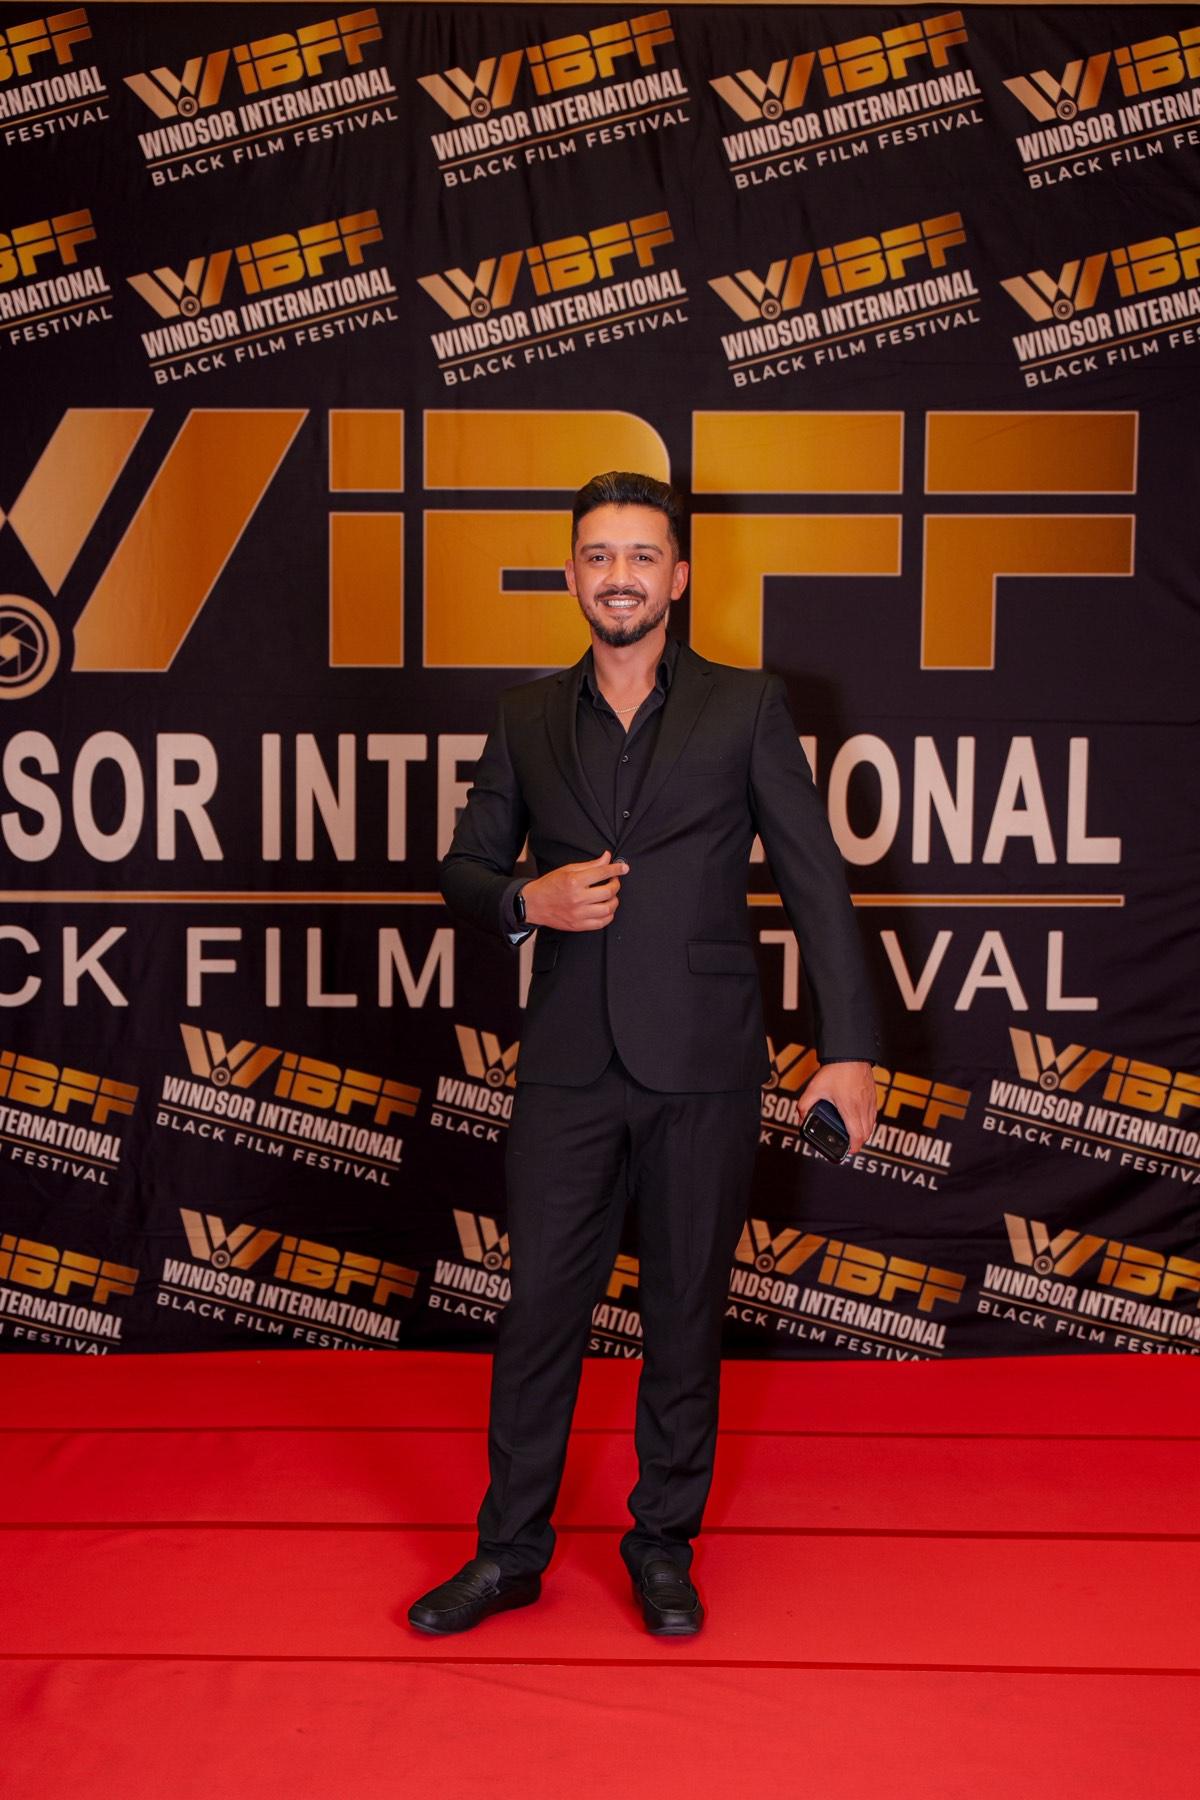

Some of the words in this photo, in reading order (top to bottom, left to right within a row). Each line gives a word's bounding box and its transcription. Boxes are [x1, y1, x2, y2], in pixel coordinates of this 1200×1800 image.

[4, 107, 109, 146] FESTIVAL
[138, 110, 239, 159] WINDSOR
[239, 67, 396, 132] INTERNATIONAL
[152, 154, 224, 186] BLACK
[233, 138, 285, 163] FILM
[294, 107, 398, 146] FESTIVAL
[431, 111, 531, 160] WINDSOR
[531, 68, 688, 133] INTERNATIONAL
[722, 112, 823, 162] WINDSOR
[823, 69, 981, 135] INTERNATIONAL
[1016, 113, 1118, 163] WINDSOR
[444, 155, 517, 187] BLACK
[525, 138, 577, 164] FILM
[586, 108, 690, 147] FESTIVAL
[735, 156, 808, 189] BLACK
[816, 140, 869, 166] FILM
[878, 110, 984, 149] FESTIVAL
[1028, 157, 1103, 189] BLACK
[1111, 140, 1163, 166] FILM
[9, 306, 113, 345] FESTIVAL
[141, 310, 240, 358] WINDSOR
[240, 267, 397, 331] INTERNATIONAL
[154, 353, 227, 385] BLACK
[235, 336, 286, 362] FILM
[295, 307, 398, 346] FESTIVAL
[430, 311, 530, 360] WINDSOR
[530, 268, 687, 333] INTERNATIONAL
[720, 312, 820, 361] WINDSOR
[821, 269, 979, 335] INTERNATIONAL
[1012, 312, 1114, 362] WINDSOR
[443, 354, 516, 386] BLACK
[524, 338, 576, 364] FILM
[585, 308, 689, 347] FESTIVAL
[733, 356, 806, 388] BLACK
[814, 339, 866, 366] FILM
[875, 309, 980, 348] FESTIVAL
[1024, 356, 1099, 388] BLACK
[1106, 339, 1160, 366] FILM
[186, 927, 455, 1008] FILM
[162, 1075, 256, 1123] WINDSOR
[256, 1101, 403, 1163] INTERNATIONAL
[430, 1112, 500, 1142] BLACK
[989, 1079, 1083, 1127] WINDSOR
[11, 1147, 109, 1185] FESTIVAL
[156, 1112, 225, 1142] BLACK
[234, 1133, 283, 1158] FILM
[293, 1149, 390, 1186] FESTIVAL
[982, 1116, 1053, 1146] BLACK
[1061, 1137, 1111, 1162] FILM
[157, 1292, 226, 1321] BLACK
[234, 1313, 284, 1336] FILM
[163, 1258, 256, 1303] WINDSOR
[256, 1283, 400, 1342] INTERNATIONAL
[428, 1295, 497, 1324] BLACK
[799, 1288, 947, 1349] INTERNATIONAL
[983, 1263, 1077, 1310] WINDSOR
[776, 1317, 827, 1342] FILM
[977, 1300, 1047, 1329] BLACK
[1055, 1320, 1106, 1343] FILM
